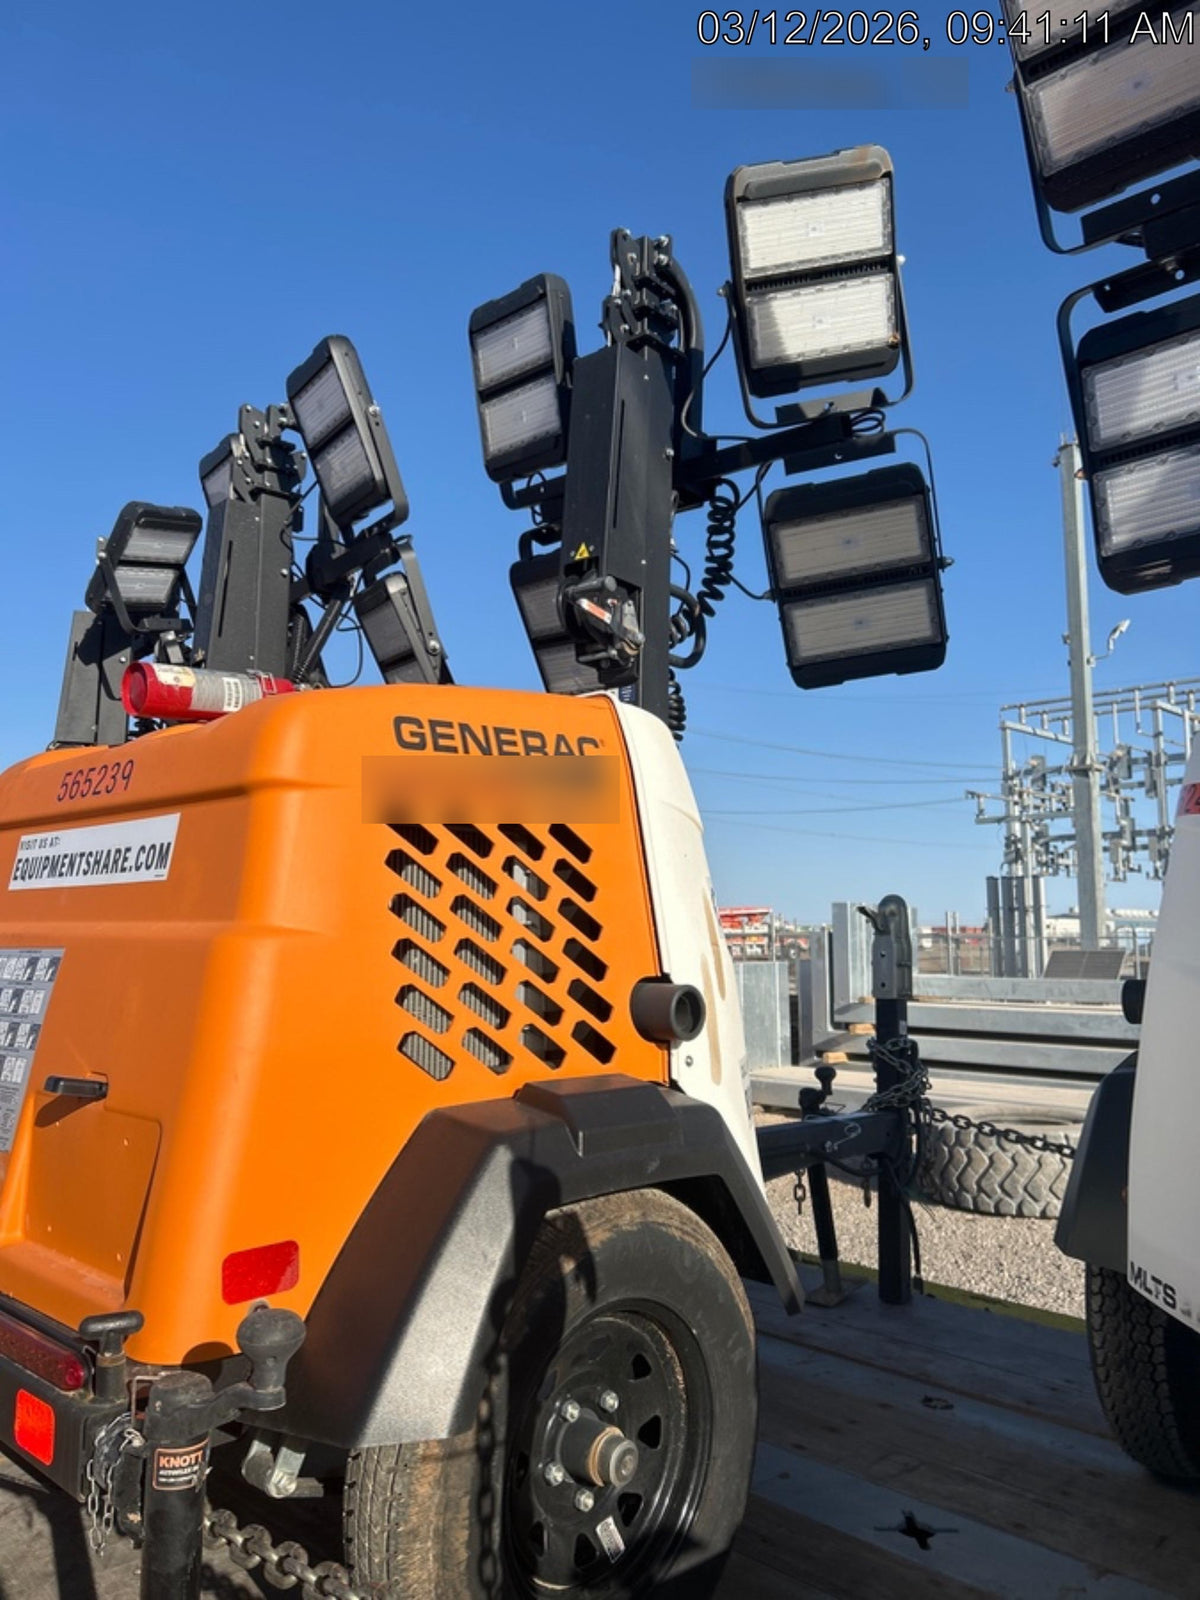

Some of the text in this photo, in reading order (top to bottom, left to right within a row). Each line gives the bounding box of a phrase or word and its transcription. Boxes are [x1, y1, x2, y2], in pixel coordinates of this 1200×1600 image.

[57, 759, 134, 802] 565239
[12, 842, 172, 882] EQUIPMENTSHARE.COM
[159, 1450, 203, 1468] KNOTT
